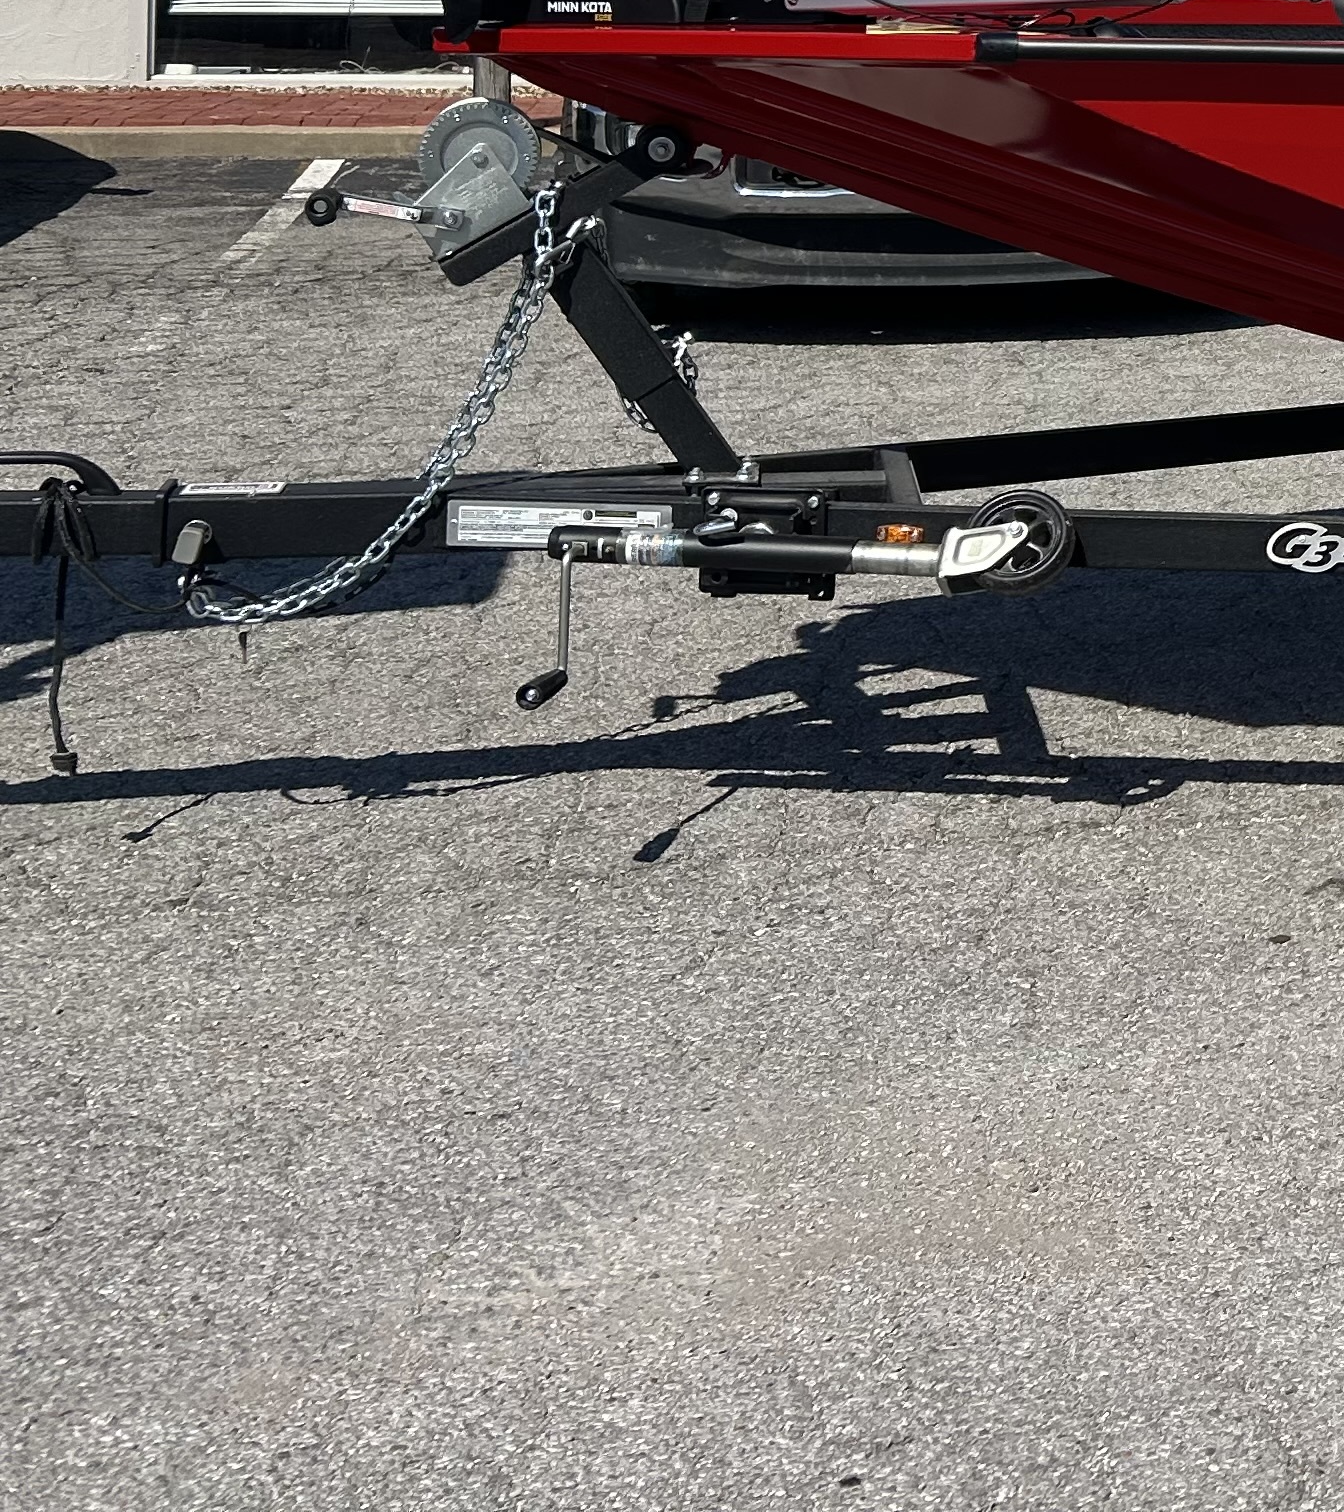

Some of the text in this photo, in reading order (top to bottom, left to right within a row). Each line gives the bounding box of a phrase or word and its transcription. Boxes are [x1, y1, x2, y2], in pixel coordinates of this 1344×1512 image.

[547, 1, 613, 13] MINN KOTA
[1271, 527, 1341, 568] G3
